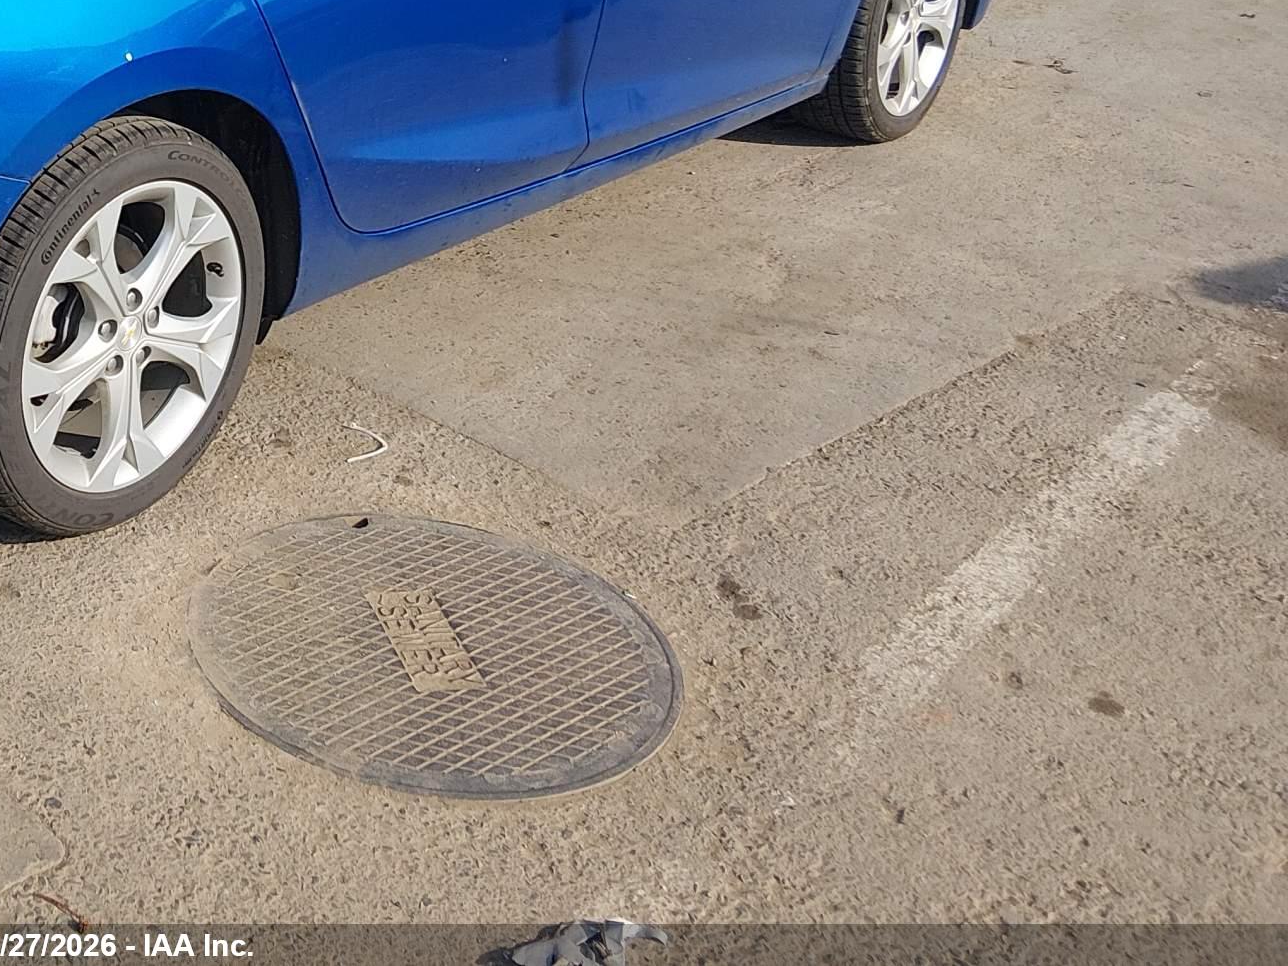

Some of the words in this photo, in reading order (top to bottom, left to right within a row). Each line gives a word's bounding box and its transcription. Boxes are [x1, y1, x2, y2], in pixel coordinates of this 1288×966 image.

[40, 193, 95, 266] Continental
[376, 605, 439, 676] SEWER
[403, 592, 484, 685] SANITARY
